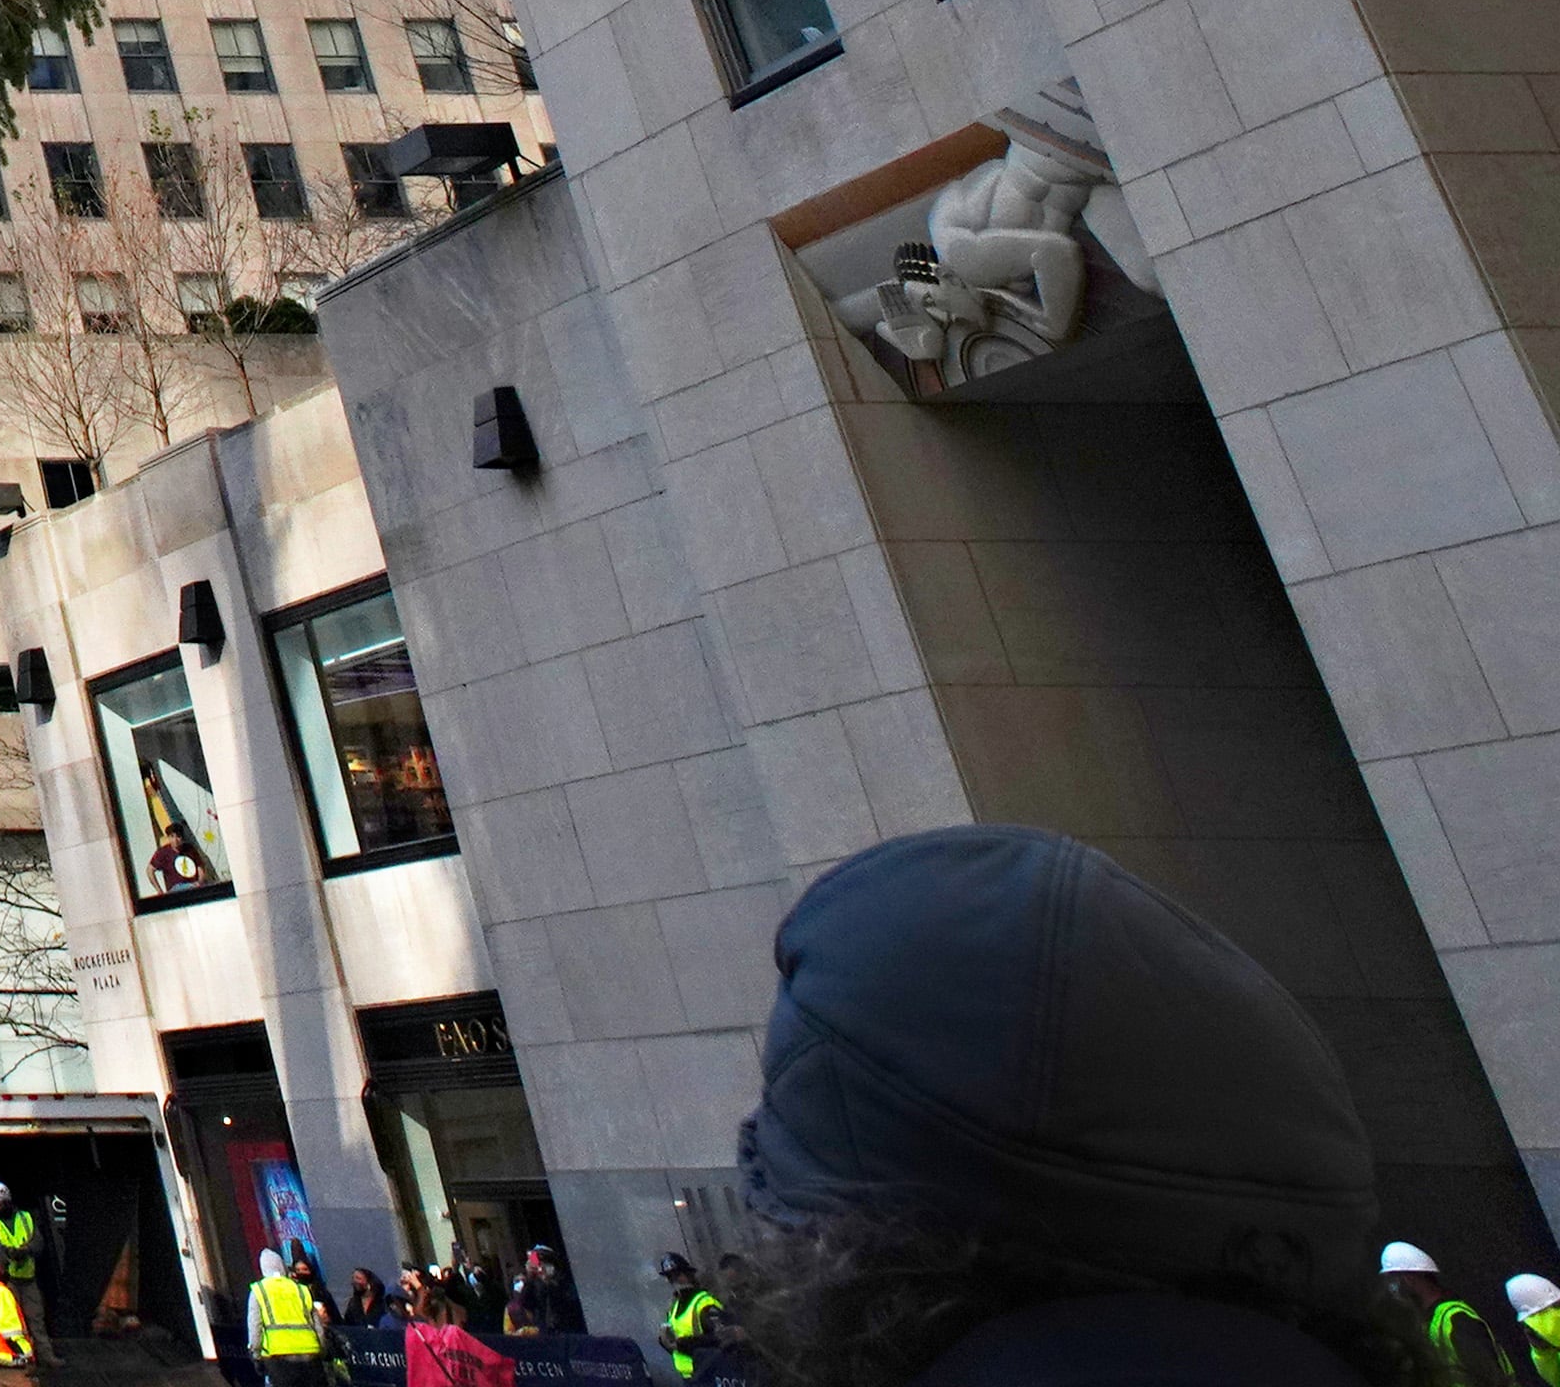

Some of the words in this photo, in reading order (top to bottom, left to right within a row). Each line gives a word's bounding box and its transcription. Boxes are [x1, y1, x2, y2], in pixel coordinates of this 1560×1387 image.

[73, 949, 132, 971] ROCKEFELLER
[93, 974, 121, 990] PLAZA
[377, 1352, 407, 1368] CENTE
